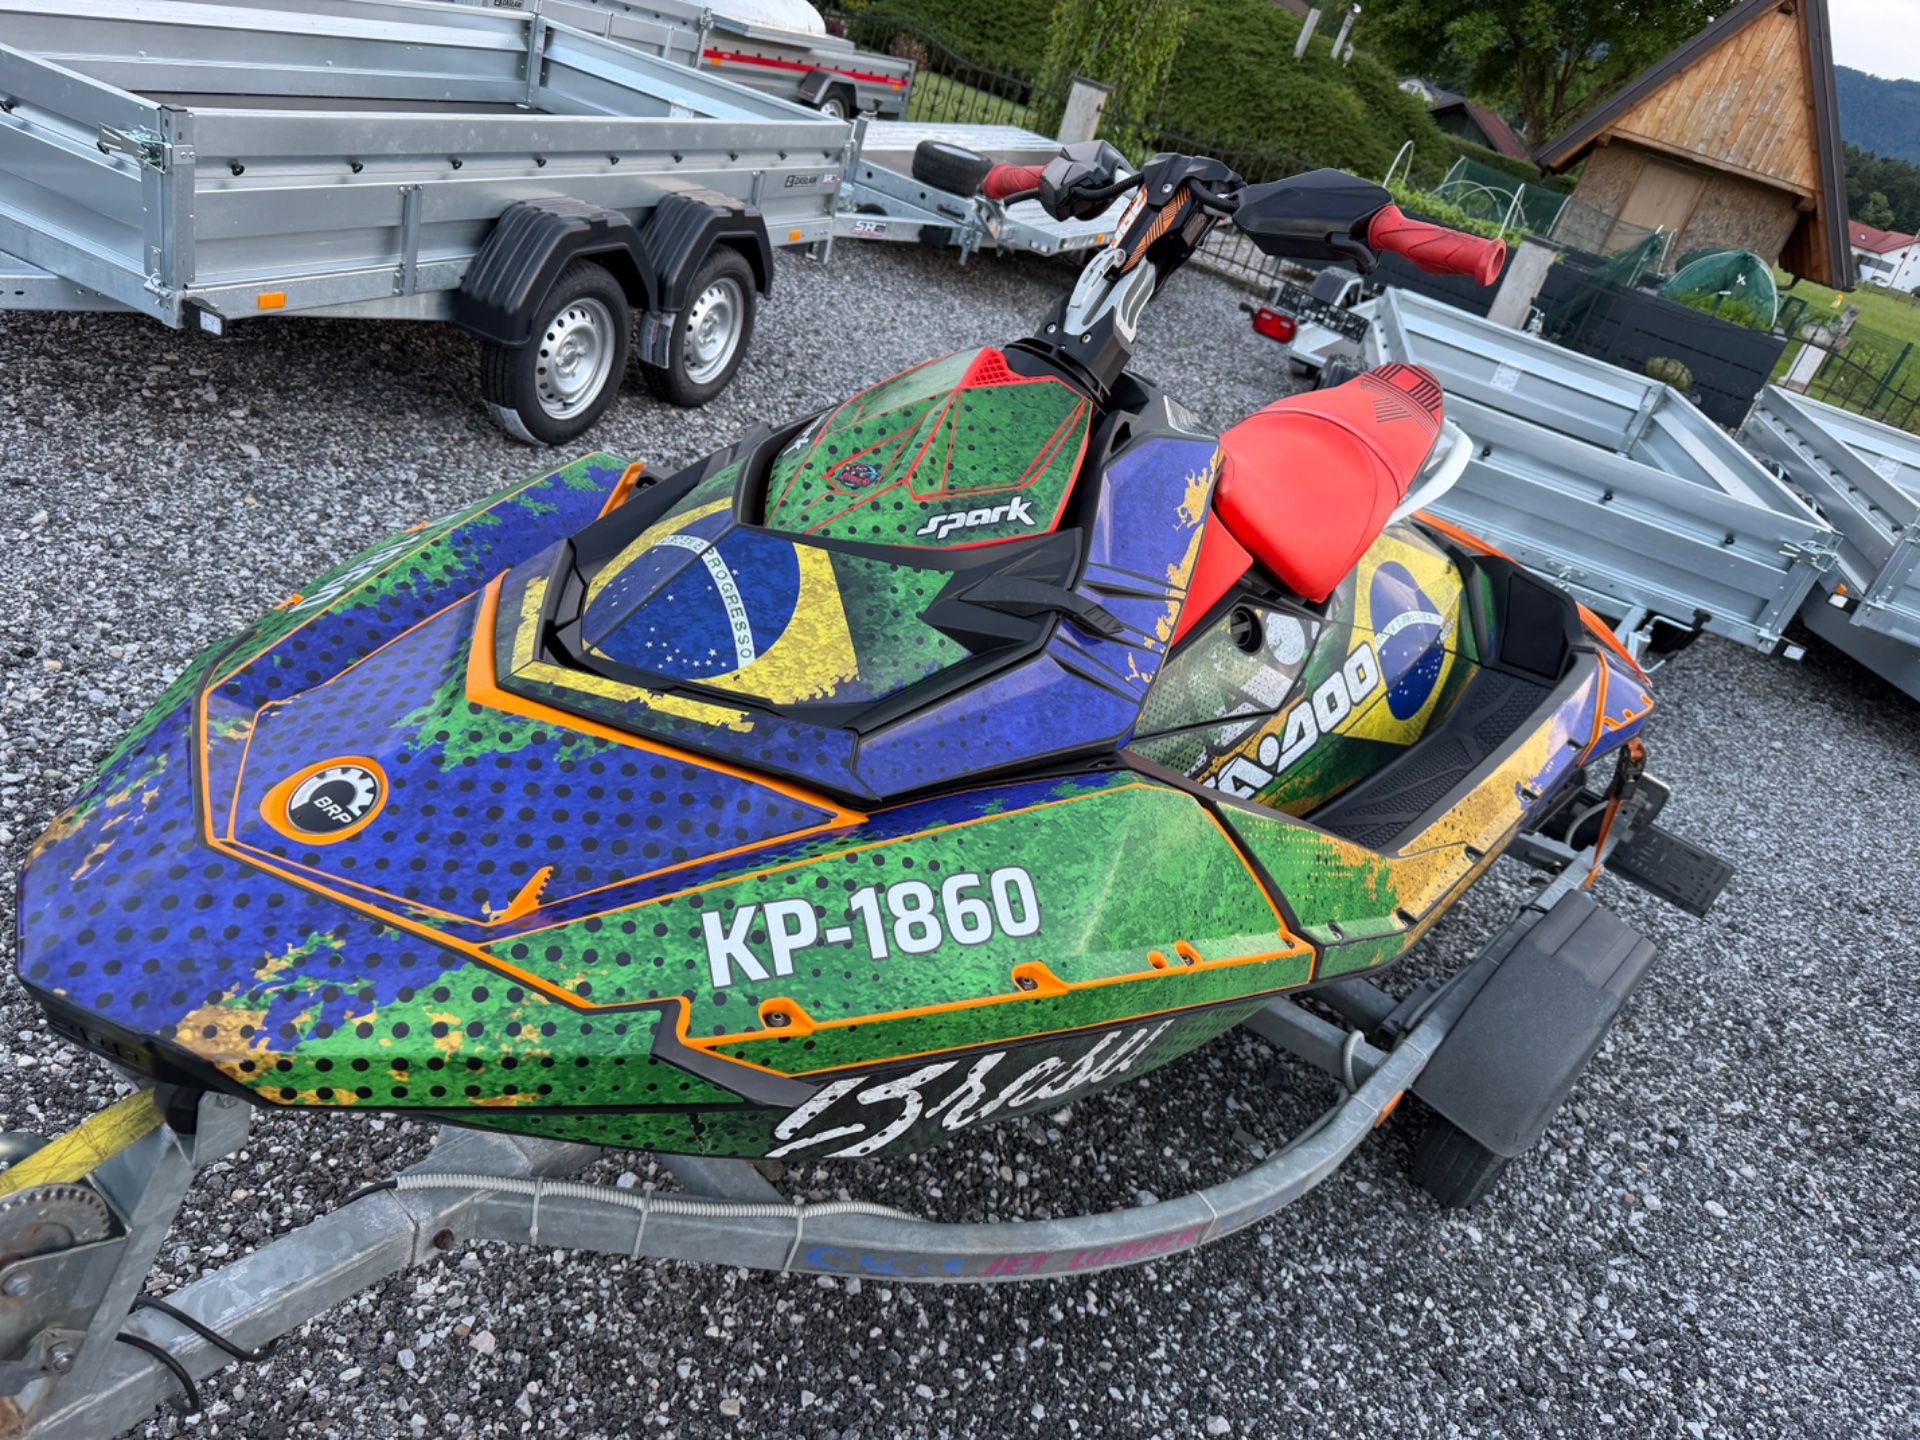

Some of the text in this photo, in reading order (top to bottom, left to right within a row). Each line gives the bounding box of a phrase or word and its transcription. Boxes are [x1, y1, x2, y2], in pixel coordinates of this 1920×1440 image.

[916, 496, 1036, 539] spark
[706, 547, 752, 659] PROGRESSO
[313, 796, 352, 823] BRP
[701, 866, 1041, 988] KP-1860
